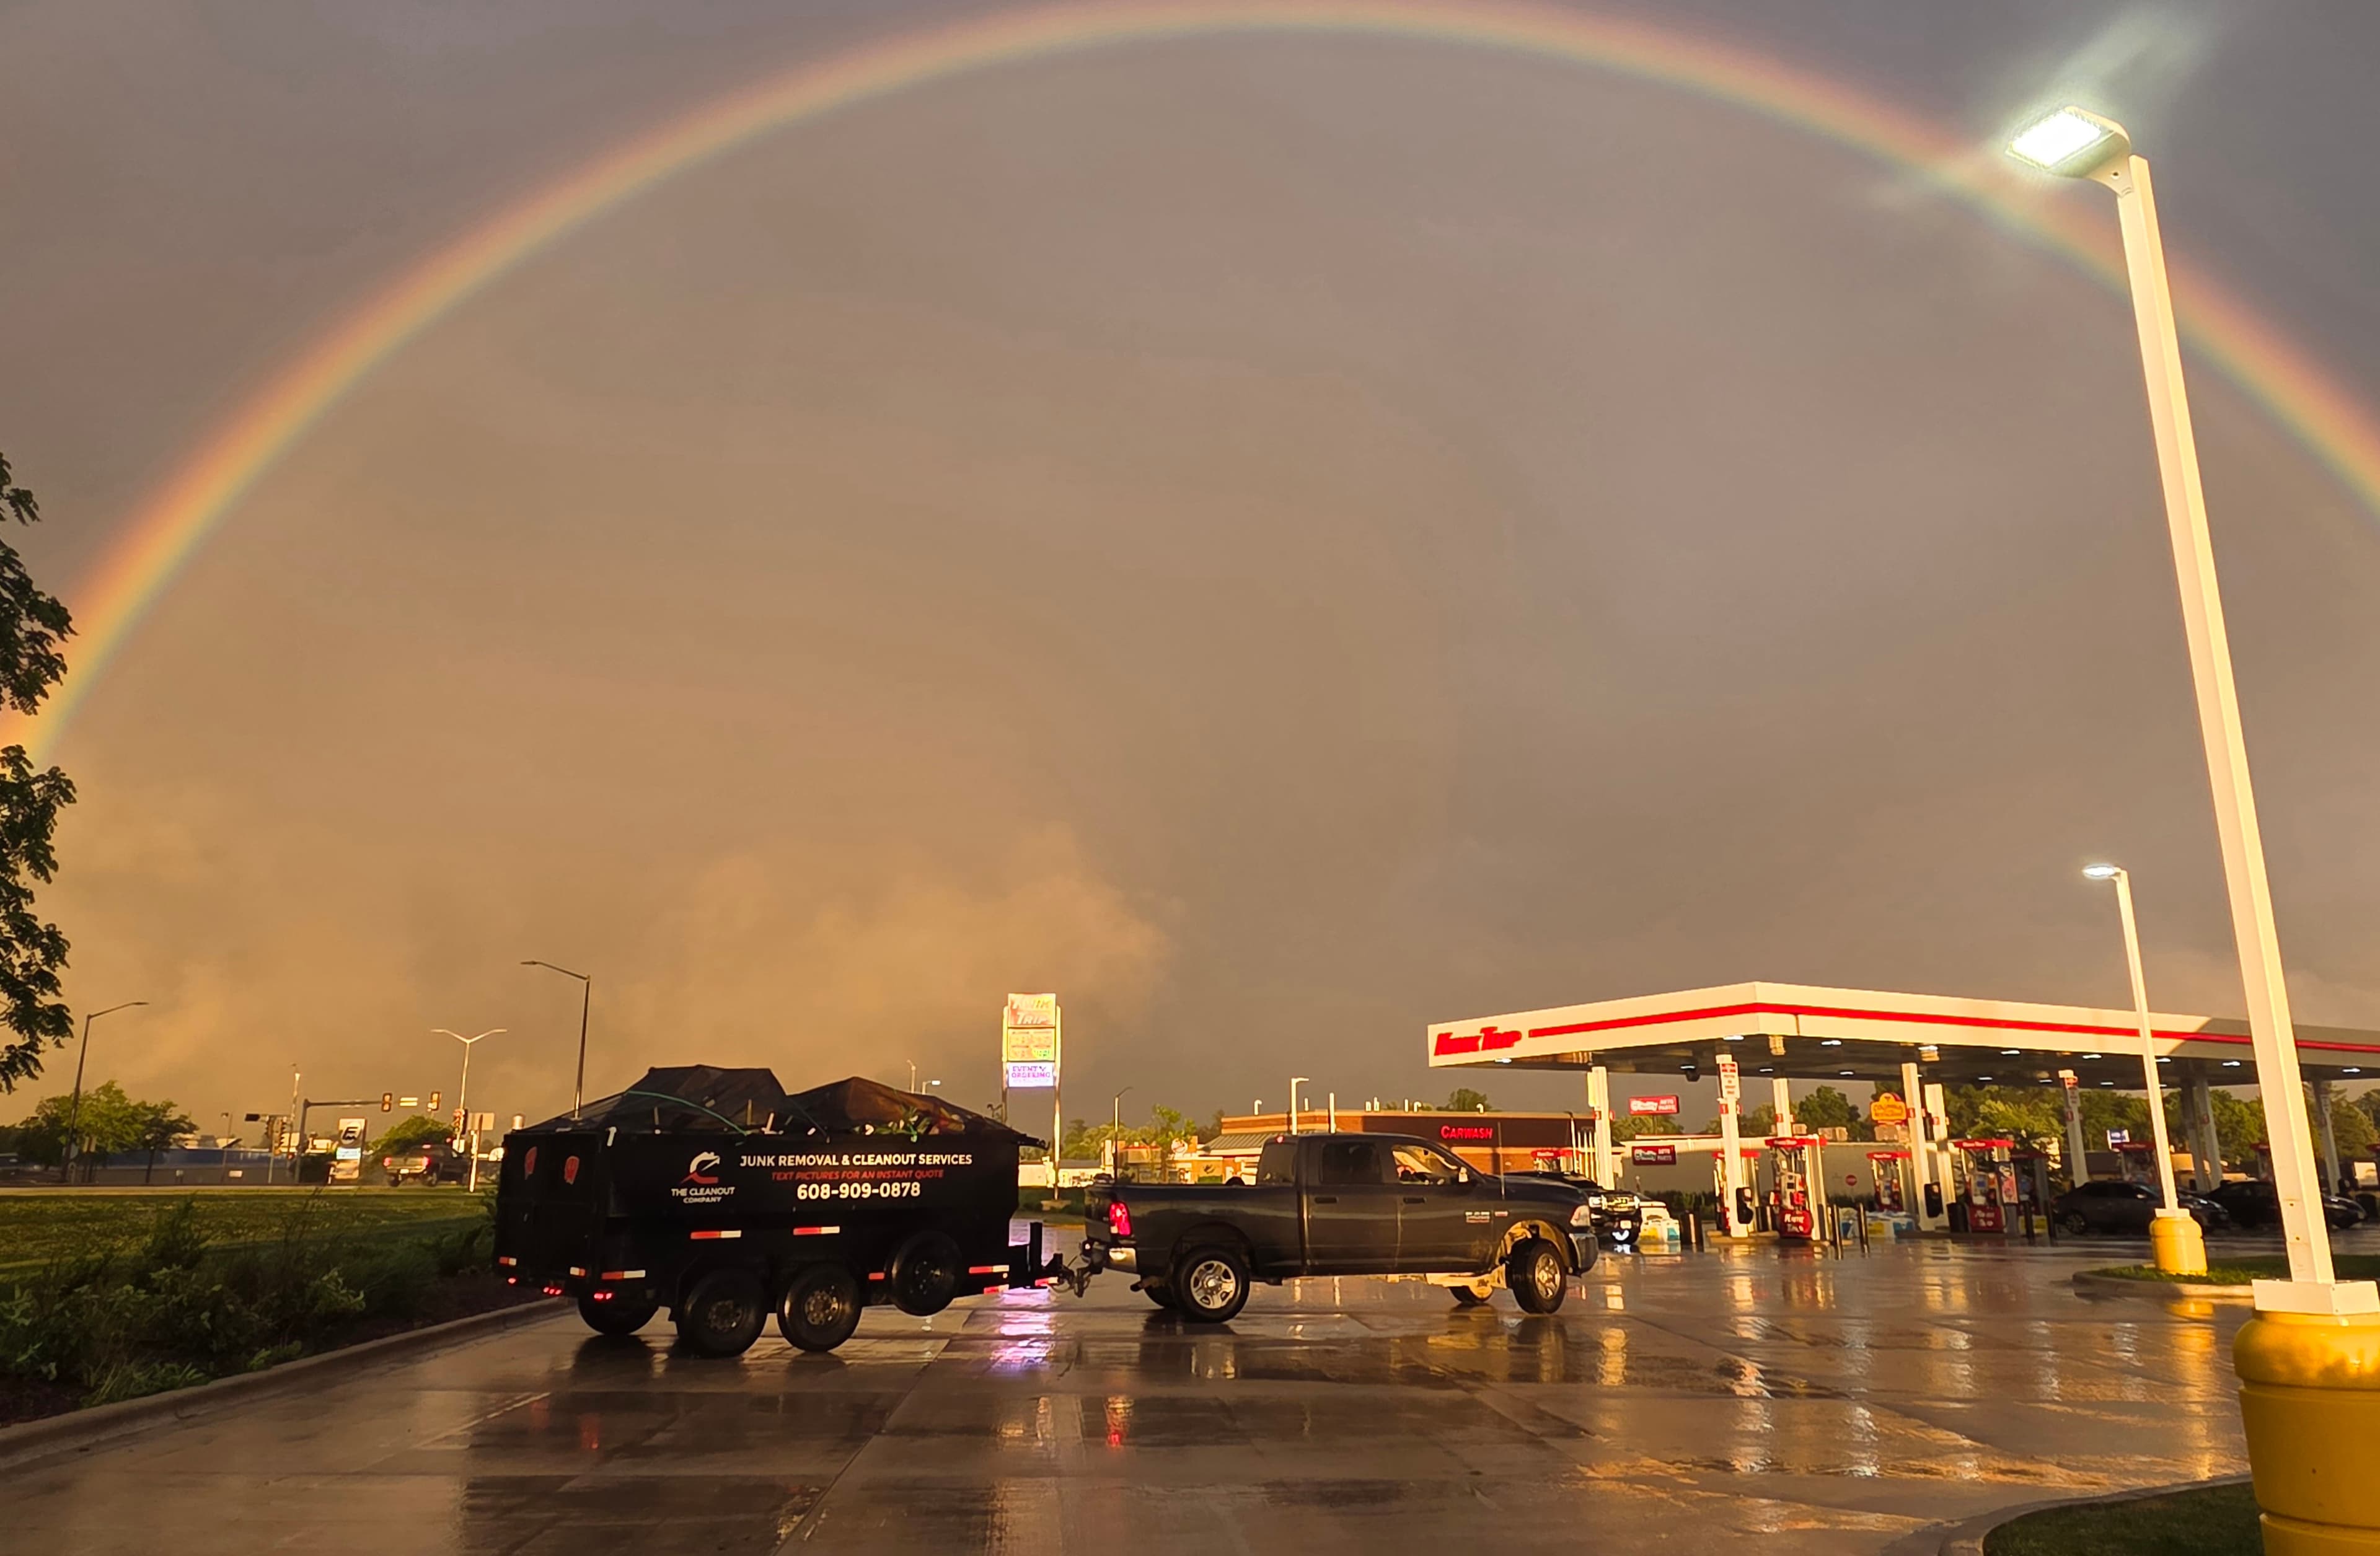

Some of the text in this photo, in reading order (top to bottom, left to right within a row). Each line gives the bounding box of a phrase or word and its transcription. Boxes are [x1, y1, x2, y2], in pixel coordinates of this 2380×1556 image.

[1440, 1125, 1493, 1139] CARWASH
[739, 1154, 972, 1167] JUNK REMOVAL & CLEANOUT SERVICES
[772, 1169, 944, 1180] TEXT PICTURES FOR AN INSTANT QUOTE
[671, 1187, 736, 1197] THE CLEANOUT
[796, 1182, 921, 1200] 608-909-0878
